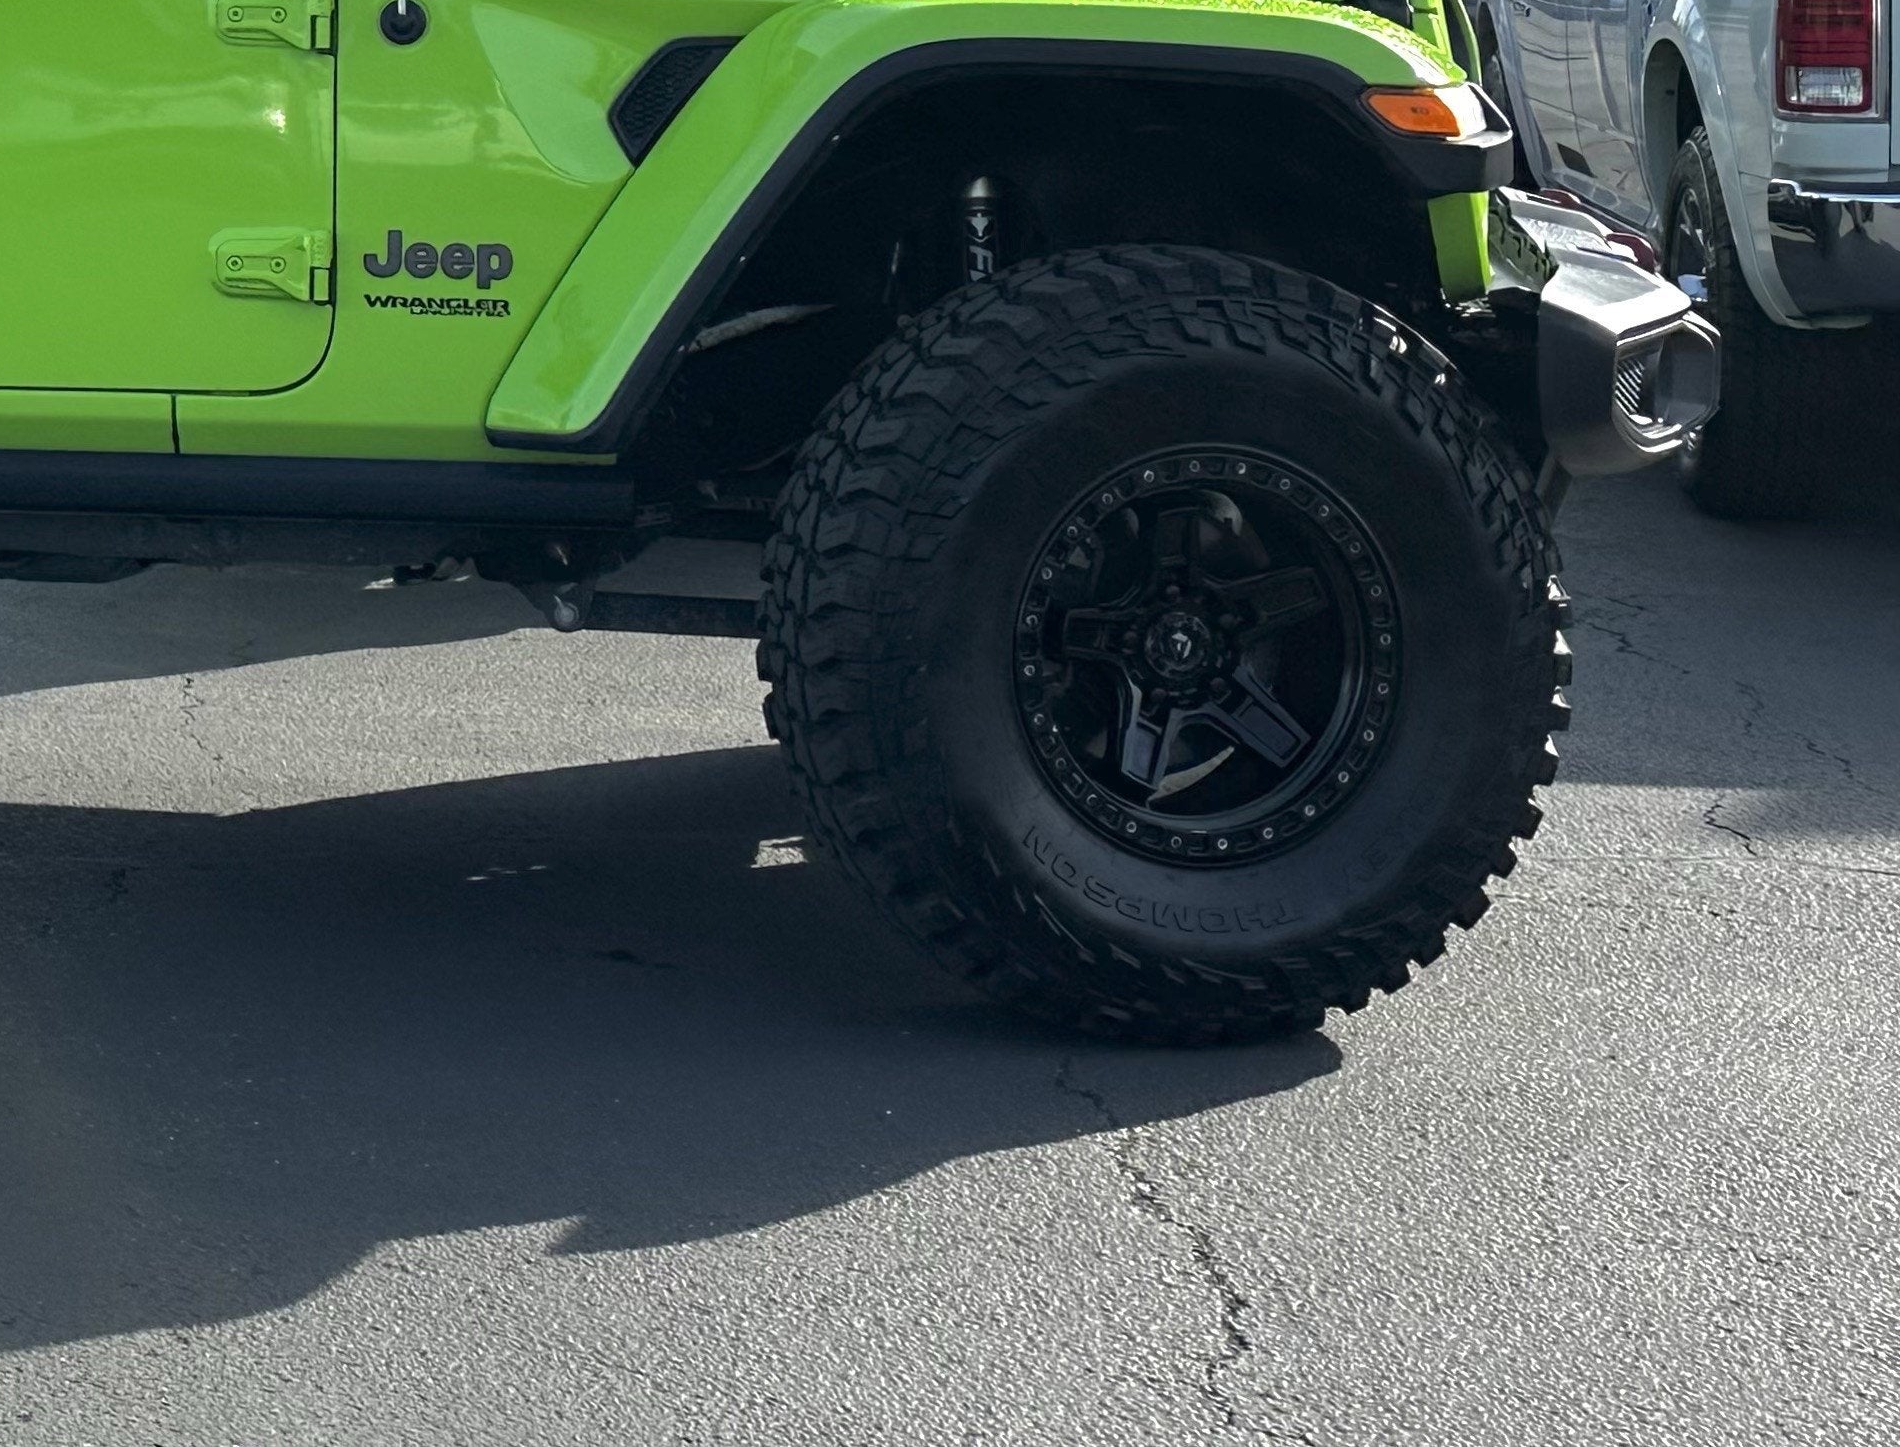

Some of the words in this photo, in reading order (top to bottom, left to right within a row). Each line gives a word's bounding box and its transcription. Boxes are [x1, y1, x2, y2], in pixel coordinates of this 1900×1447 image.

[364, 230, 513, 289] Jeep
[364, 294, 511, 313] WRANGLER
[1021, 825, 1304, 934] THOMPSON
